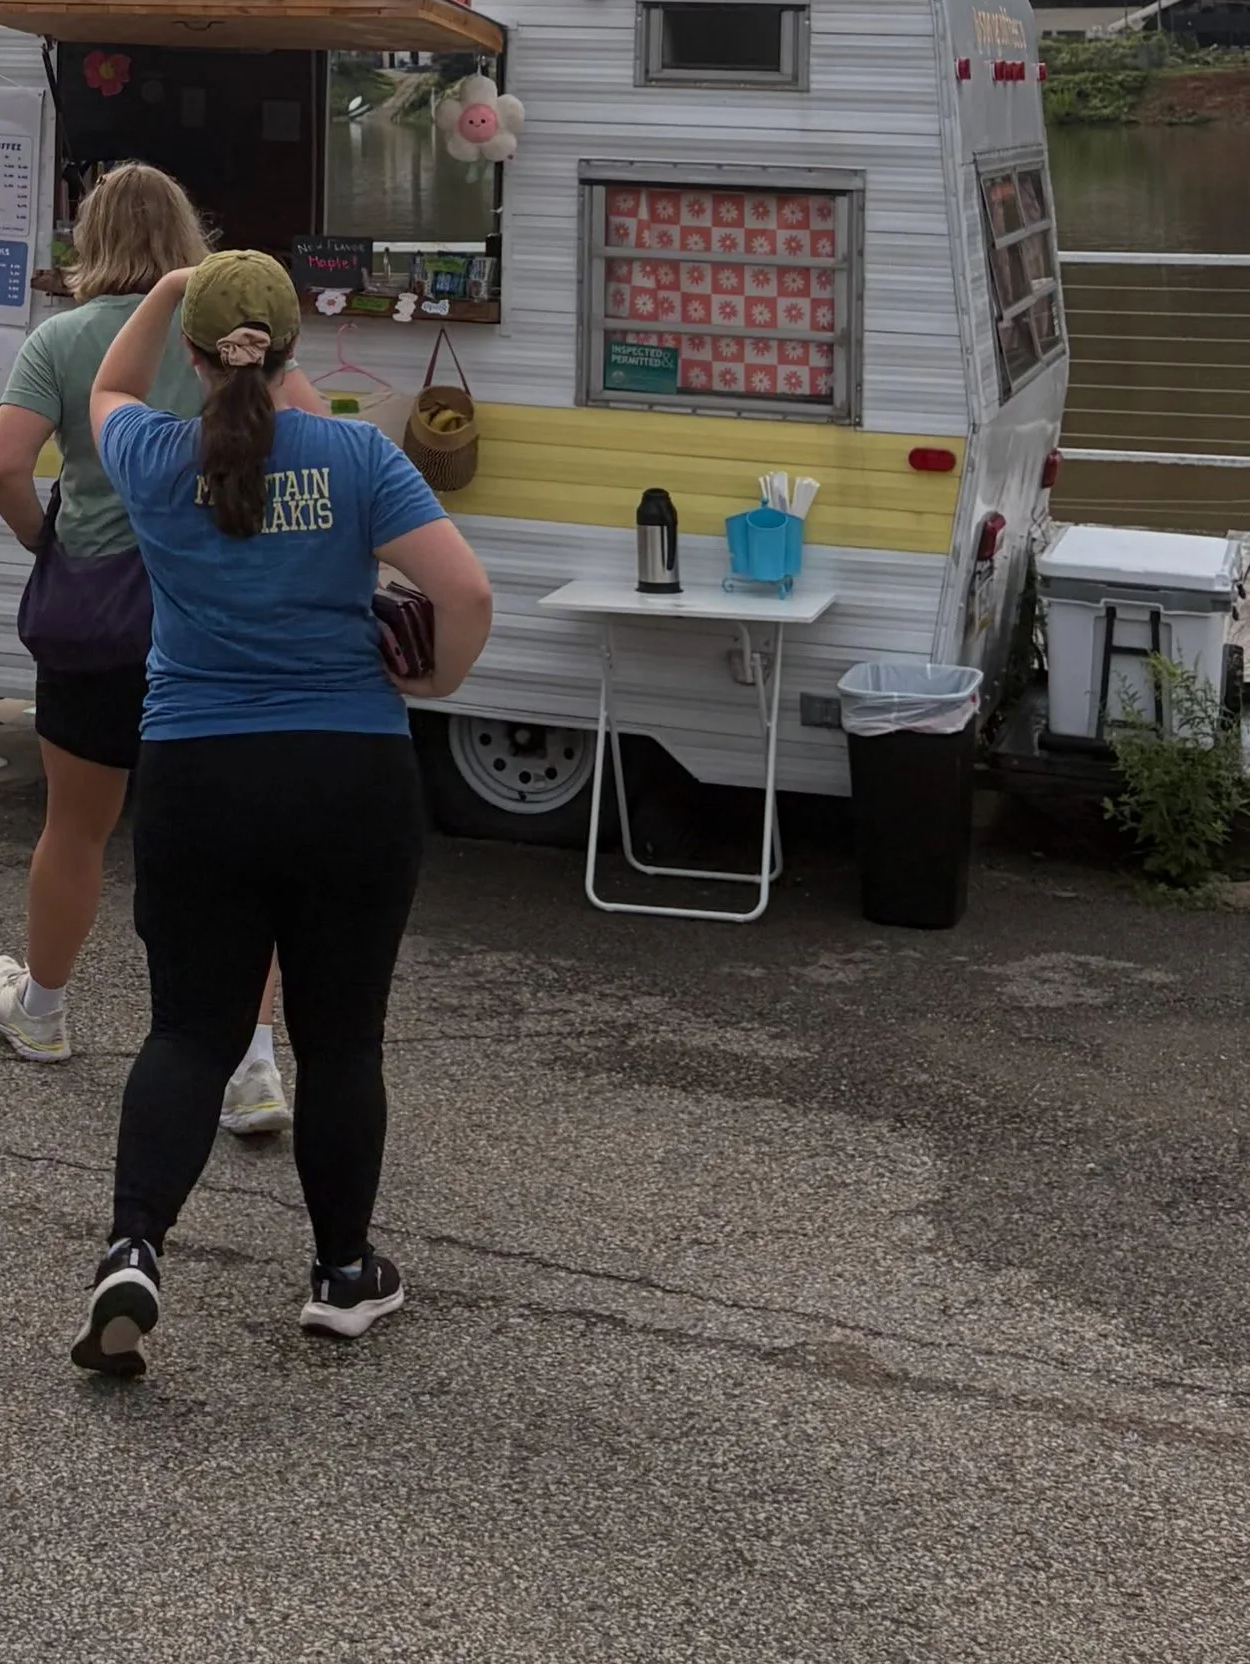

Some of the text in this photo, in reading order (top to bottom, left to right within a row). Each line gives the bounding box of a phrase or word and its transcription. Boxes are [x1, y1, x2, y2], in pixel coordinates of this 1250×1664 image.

[611, 344, 663, 358] INSPECTED
[611, 354, 661, 368] PERMITTED
[194, 468, 330, 506] MTAIN
